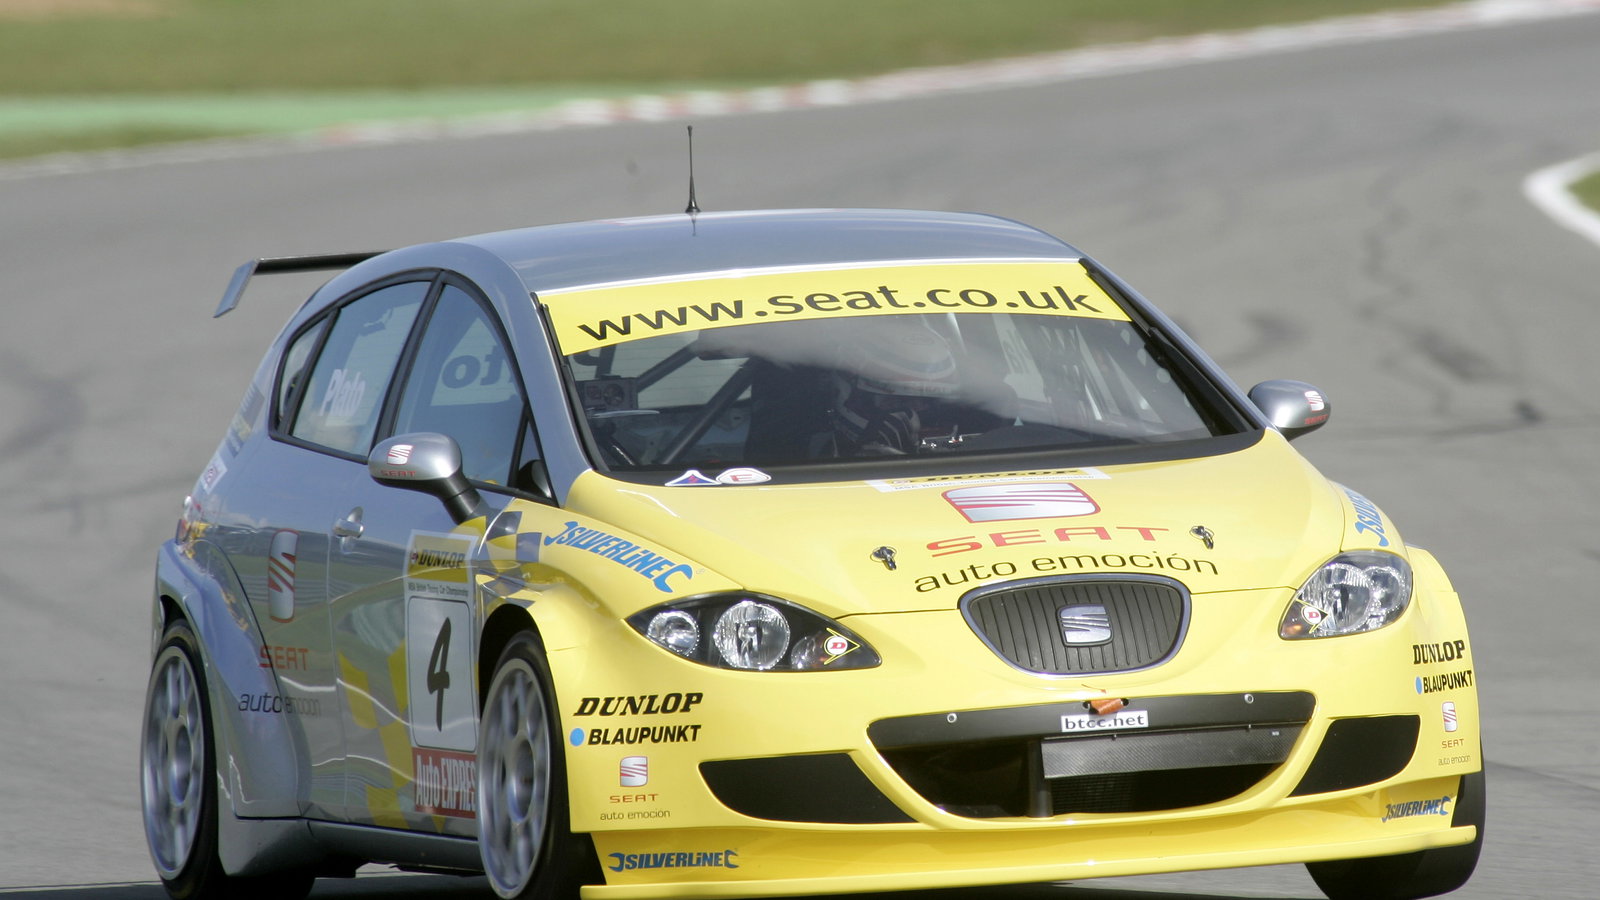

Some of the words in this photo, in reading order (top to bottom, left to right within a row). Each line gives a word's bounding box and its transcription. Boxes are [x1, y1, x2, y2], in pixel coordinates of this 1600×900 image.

[577, 285, 1103, 341] www.seat.co.uk
[320, 369, 367, 416] Plato
[926, 526, 1170, 558] SEAT
[418, 549, 466, 568] DUNLOP
[914, 560, 1017, 593] auto
[1032, 550, 1219, 575] emoción
[259, 645, 309, 671] SEAT
[1413, 639, 1465, 664] DUNLOP
[427, 617, 451, 732] 4
[1422, 670, 1473, 693] BLAUPUNKT
[238, 692, 282, 713] auto
[573, 692, 703, 716] DUNLOP
[1065, 714, 1145, 730] btcc.net
[588, 725, 701, 745] BLAUPUNKT
[1441, 738, 1464, 749] SEAT
[416, 755, 440, 808] Auto
[609, 793, 659, 803] SEAT
[600, 811, 625, 820] auto
